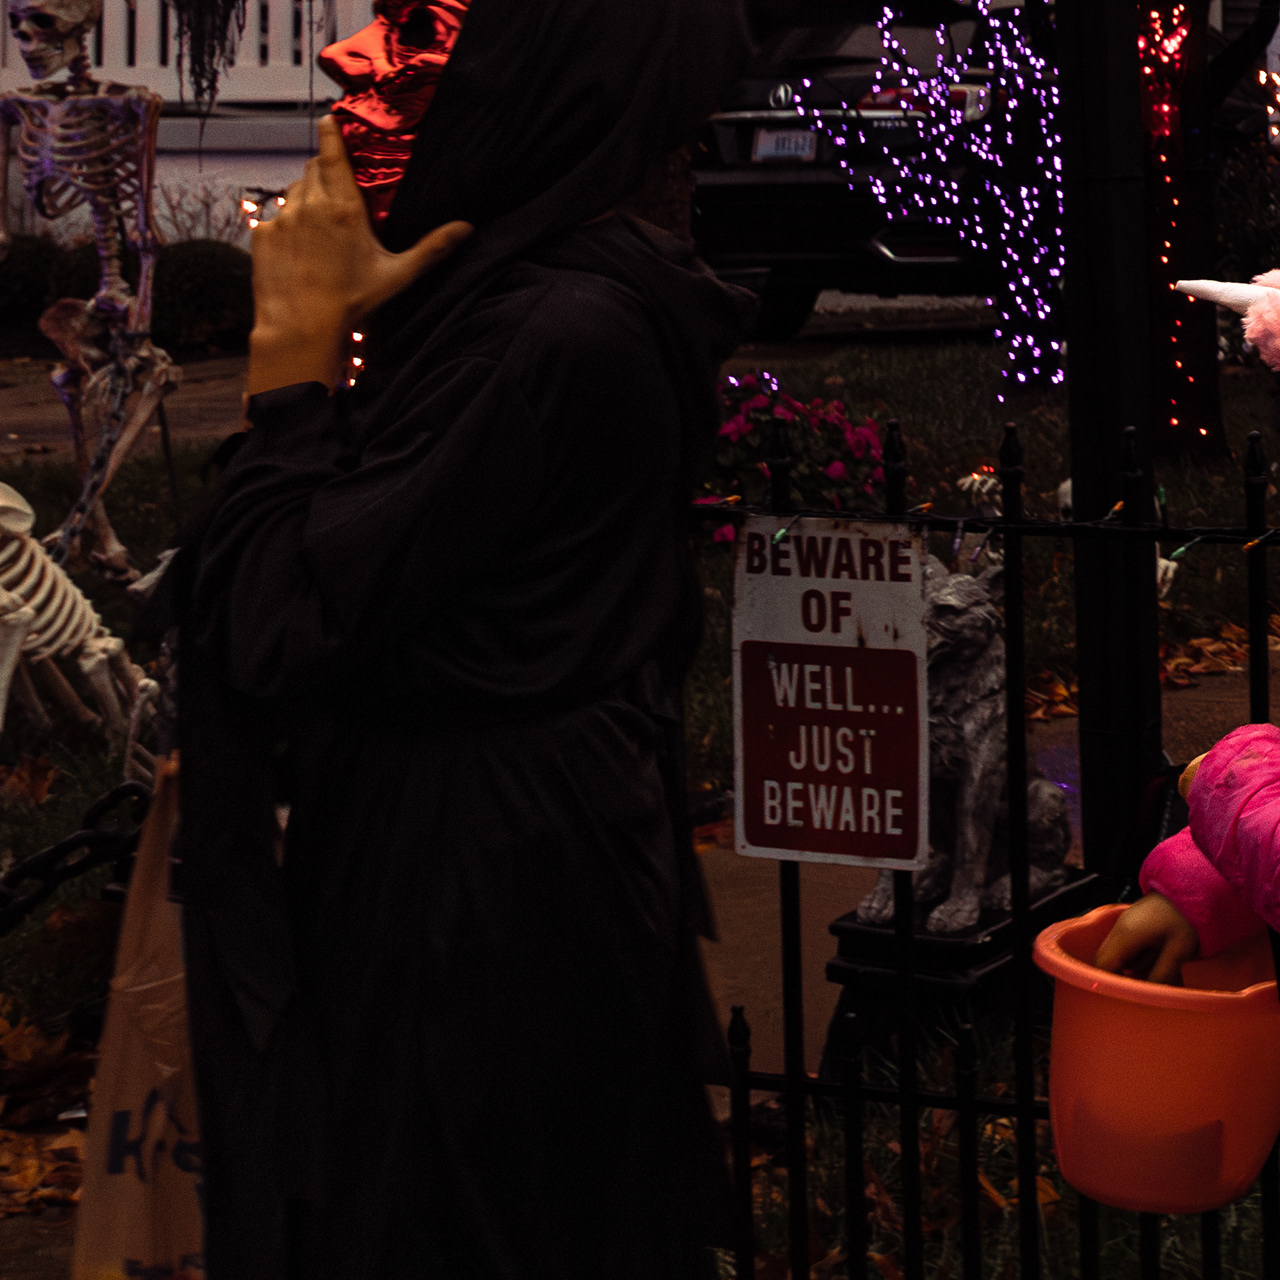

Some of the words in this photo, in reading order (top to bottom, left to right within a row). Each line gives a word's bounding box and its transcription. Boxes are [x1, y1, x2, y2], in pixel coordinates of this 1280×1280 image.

[745, 531, 912, 583] BEWARE
[801, 589, 852, 634] OF
[788, 724, 877, 775] JUST
[763, 779, 904, 837] BEWARE
